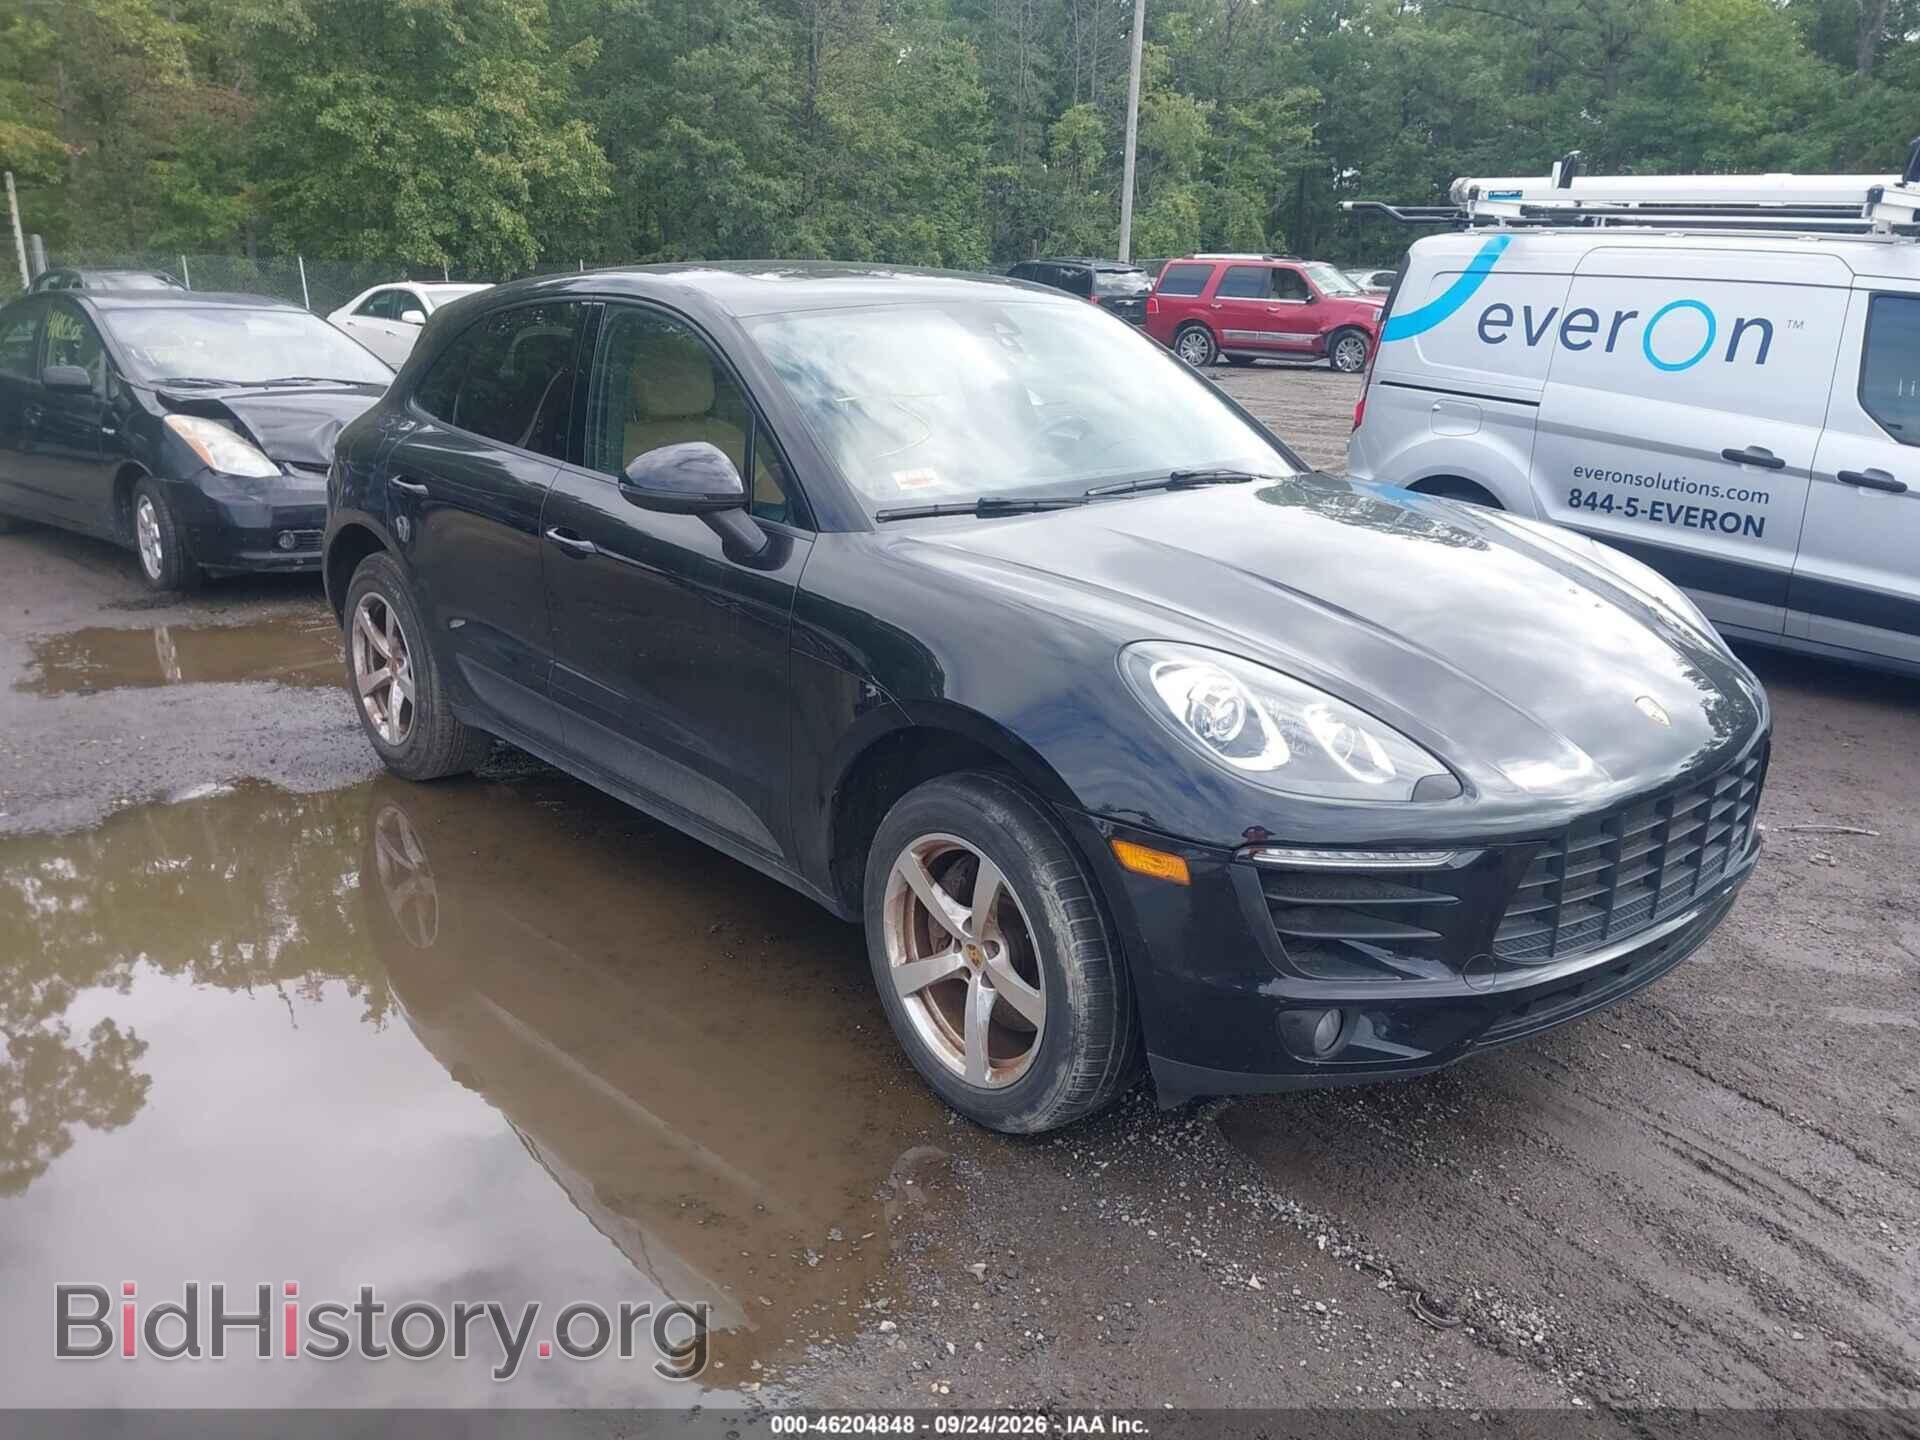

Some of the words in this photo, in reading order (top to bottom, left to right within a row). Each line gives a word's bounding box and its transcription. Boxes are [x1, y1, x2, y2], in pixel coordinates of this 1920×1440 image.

[1478, 300, 1774, 371] everOn
[1785, 319, 1804, 330] TM
[1573, 465, 1769, 504] everonsolutions.com
[1568, 488, 1765, 538] 844-5-EVERON
